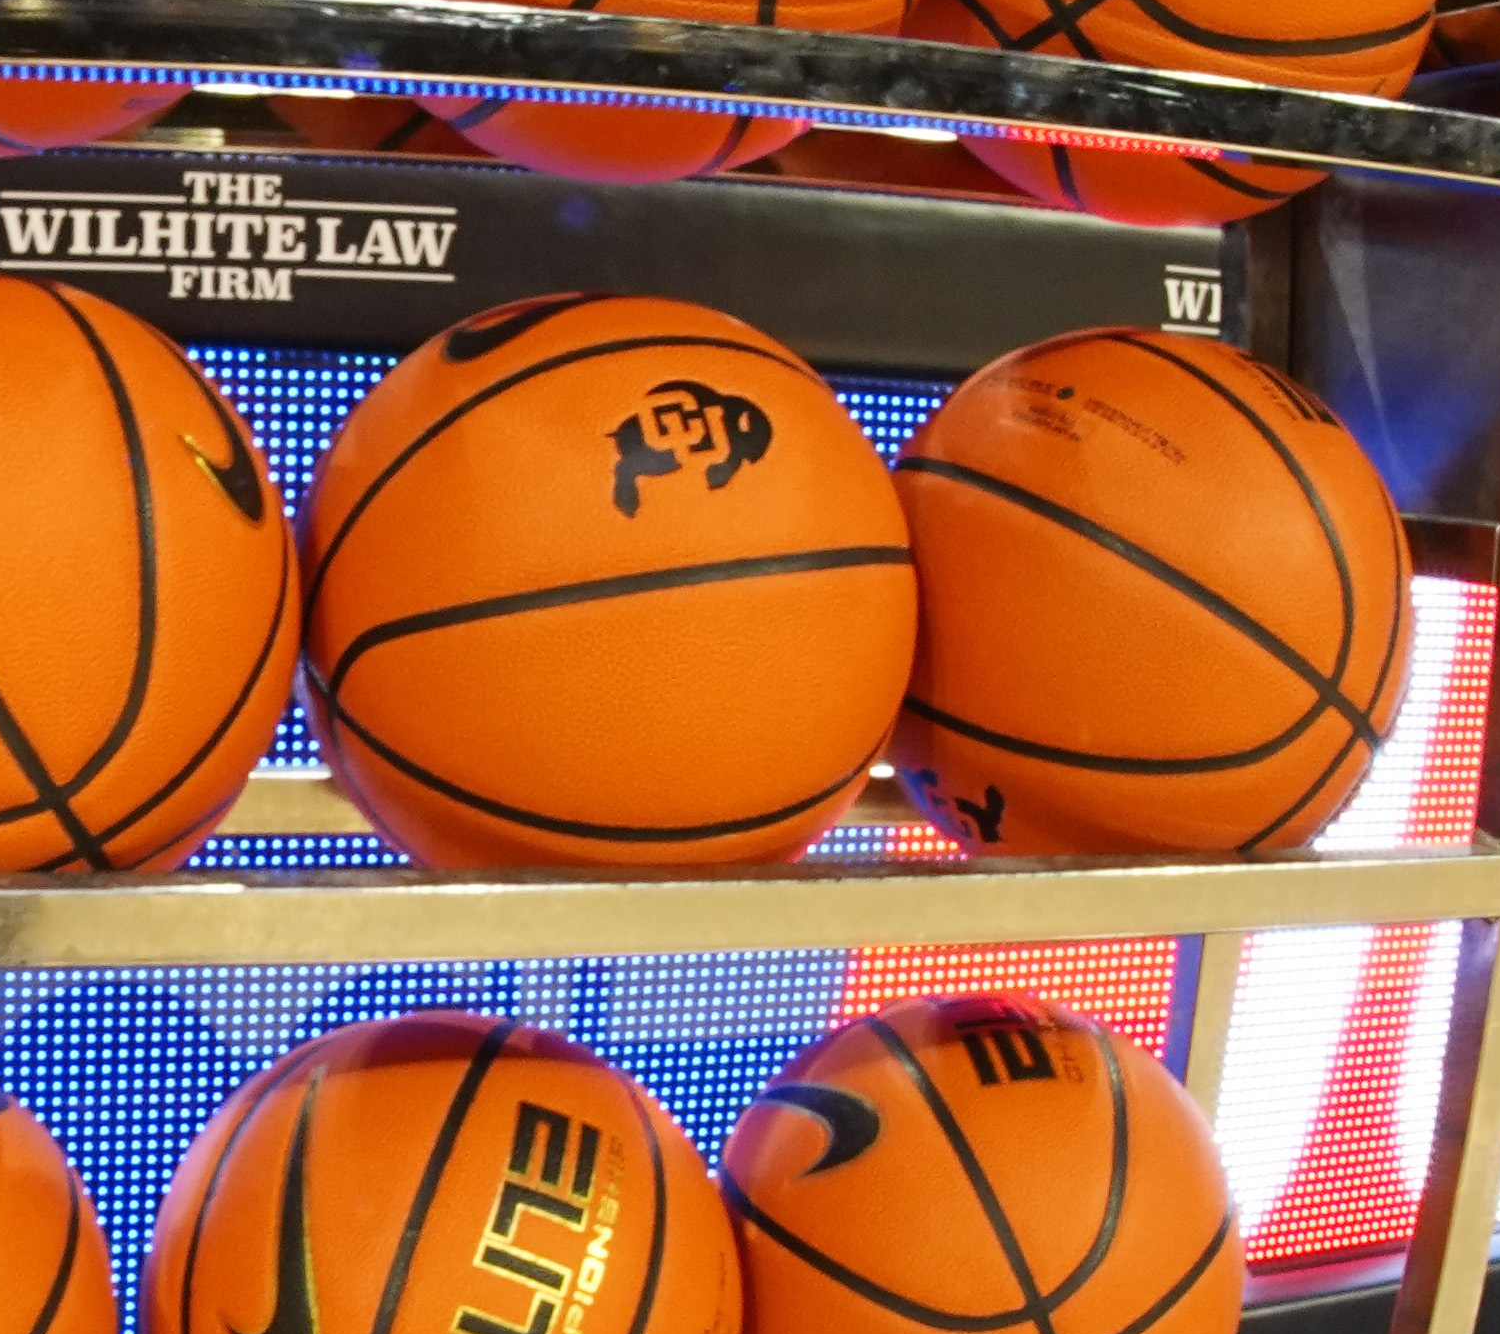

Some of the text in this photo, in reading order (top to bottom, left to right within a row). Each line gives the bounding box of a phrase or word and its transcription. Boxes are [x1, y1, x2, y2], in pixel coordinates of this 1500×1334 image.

[183, 170, 284, 207] THE
[0, 207, 458, 267] WILHITE LAW
[169, 266, 294, 302] FIRM
